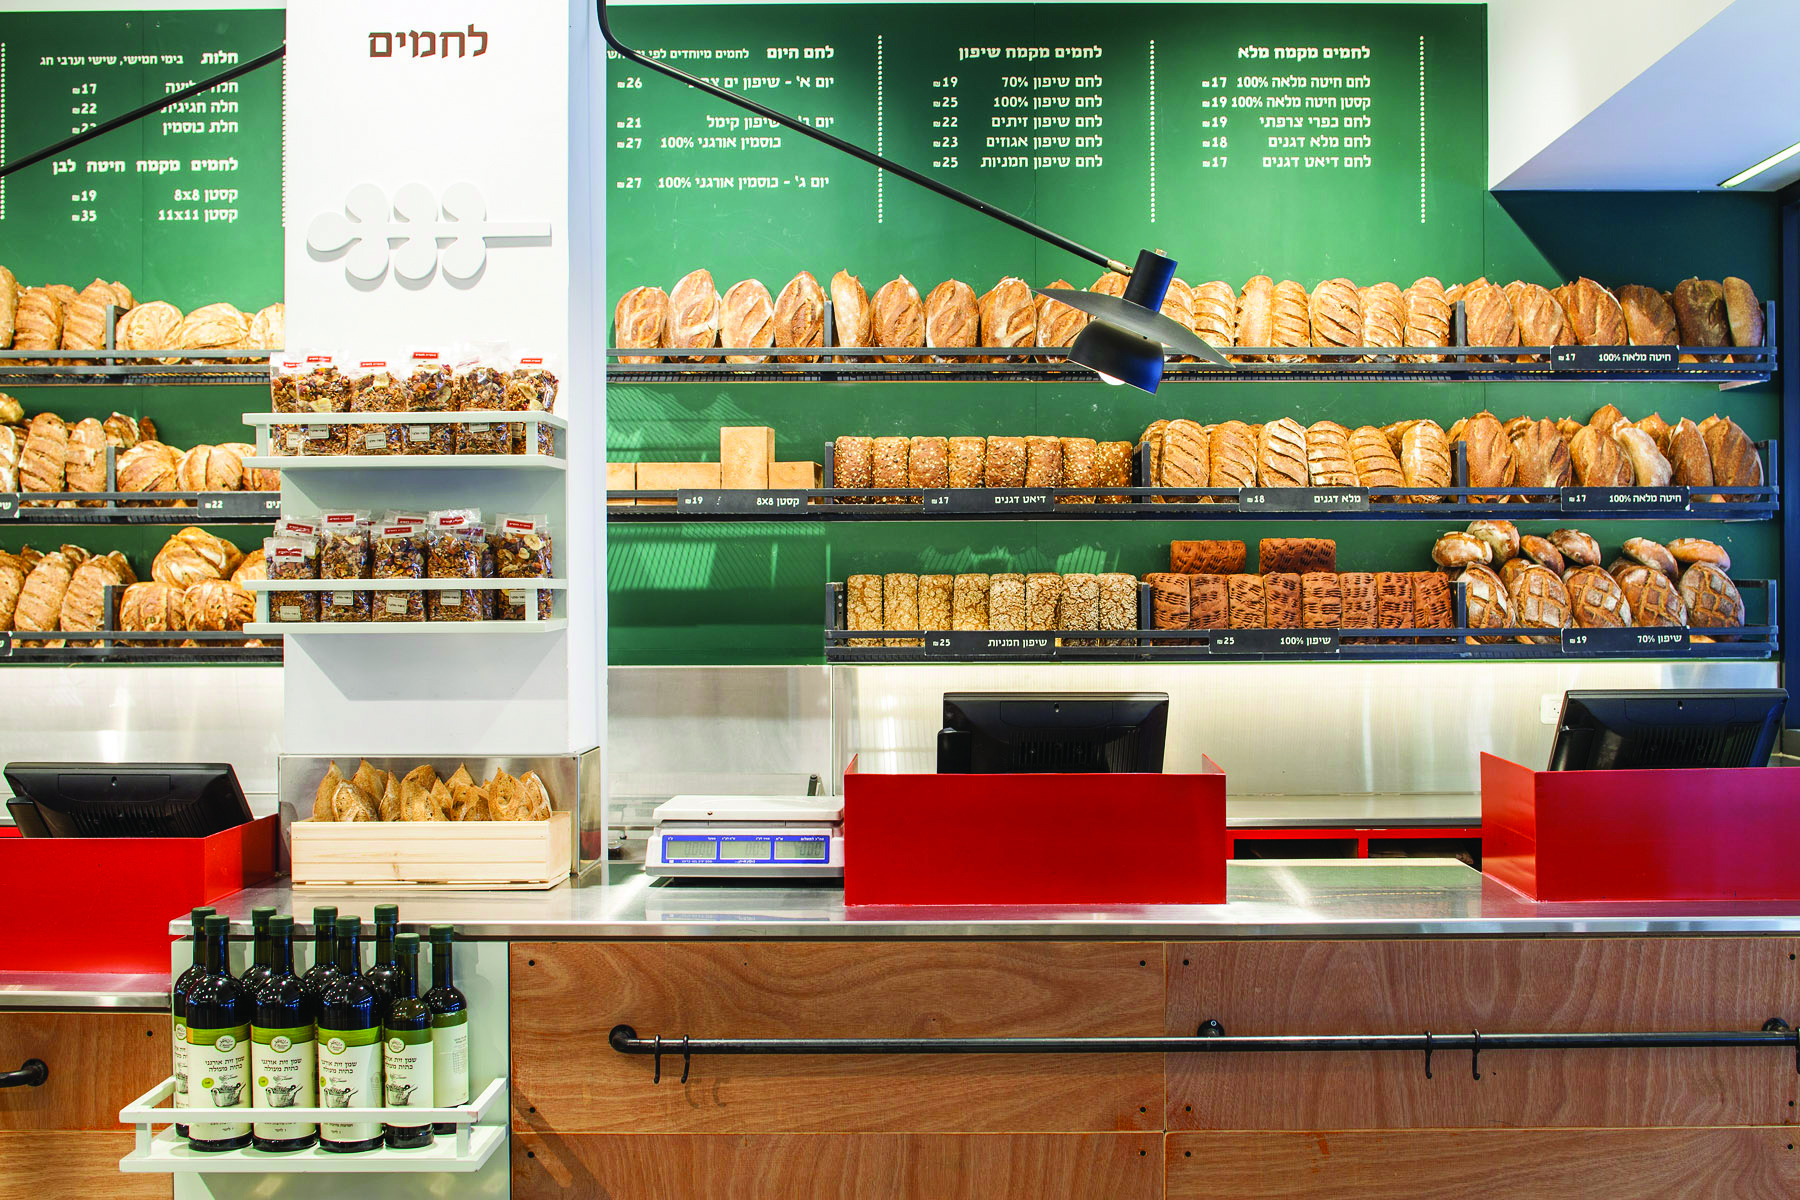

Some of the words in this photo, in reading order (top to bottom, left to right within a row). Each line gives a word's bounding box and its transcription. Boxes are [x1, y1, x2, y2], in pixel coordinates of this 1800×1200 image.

[368, 24, 488, 58] לחמים
[200, 50, 238, 64] חלות
[648, 48, 666, 59] לפי
[670, 50, 711, 58] מיוחדים
[716, 48, 749, 58] לחמים
[767, 48, 799, 59] היום
[804, 45, 833, 58] לחם
[959, 48, 1001, 60] שיפון
[1006, 47, 1049, 61] מקמח
[1055, 45, 1102, 58] לחמים
[1238, 45, 1269, 58] מלא
[1274, 47, 1318, 61] מקמח
[1323, 46, 1370, 58] לחמים
[40, 57, 53, 65] חג
[57, 56, 84, 65] וערבי
[88, 56, 116, 65] שישי
[120, 56, 157, 65] חמישי,
[161, 55, 183, 63] בימי
[724, 77, 739, 88] ים
[743, 77, 780, 90] שיפון
[816, 77, 833, 88] יום
[1002, 76, 1028, 87] 70%
[1034, 77, 1070, 89] שיפון
[1075, 75, 1102, 87] לחם
[1237, 76, 1268, 88] 100%
[1272, 75, 1306, 87] מלאה
[1311, 77, 1342, 87] חיטה
[1346, 75, 1370, 88] לחם
[211, 100, 238, 112] חלה
[994, 96, 1028, 107] 100%
[1033, 97, 1070, 109] שיפון
[1075, 94, 1102, 107] לחם
[1232, 96, 1263, 107] 100%
[1267, 95, 1301, 107] מלאה
[1306, 97, 1336, 107] חיטה
[1341, 97, 1371, 110] קסטן
[208, 119, 238, 133] חלת
[707, 115, 739, 131] קימל
[744, 117, 780, 130] שיפון
[816, 117, 833, 128] יום
[992, 117, 1028, 127] זיתים
[1034, 117, 1070, 129] שיפון
[1075, 114, 1102, 127] לחם
[1260, 117, 1303, 127] צרפתי
[1308, 117, 1338, 127] כפרי
[1344, 115, 1371, 127] לחם
[163, 122, 204, 135] כוסמין
[661, 137, 694, 148] 100%
[698, 137, 736, 148] אורגני
[741, 137, 781, 150] כוסמין
[987, 137, 1028, 147] אגוזים
[1034, 137, 1070, 149] שיפון
[1075, 134, 1102, 147] לחם
[1269, 137, 1305, 147] דגנים
[1310, 135, 1339, 147] מלא
[1344, 135, 1371, 147] לחם
[191, 157, 238, 171] לחמים
[981, 157, 1028, 167] חמניות
[1034, 157, 1070, 169] שיפון
[1076, 154, 1102, 167] לחם
[1263, 157, 1299, 167] דגנים
[1305, 157, 1339, 167] דיאט
[1344, 155, 1371, 167] לחם
[53, 159, 75, 175] לבן
[87, 161, 125, 172] חיטה
[136, 160, 180, 174] מקמח
[659, 177, 691, 188] 100%
[695, 177, 734, 188] אורגני
[738, 177, 778, 190] כוסמין
[811, 177, 829, 188] יום
[204, 189, 238, 203] קסטן
[204, 209, 238, 223] קסטן
[1599, 353, 1621, 361] 100%
[1623, 352, 1647, 361] מלאה
[777, 497, 799, 507] קסטן
[995, 496, 1019, 504] דגנים
[1342, 494, 1361, 502] מלא
[1633, 494, 1657, 502] מלאה
[988, 639, 1019, 647] חמניות
[1023, 639, 1047, 648] שיפון
[1306, 637, 1331, 646] שיפון
[1637, 635, 1655, 643] 70%
[1658, 635, 1682, 644] שיפון
